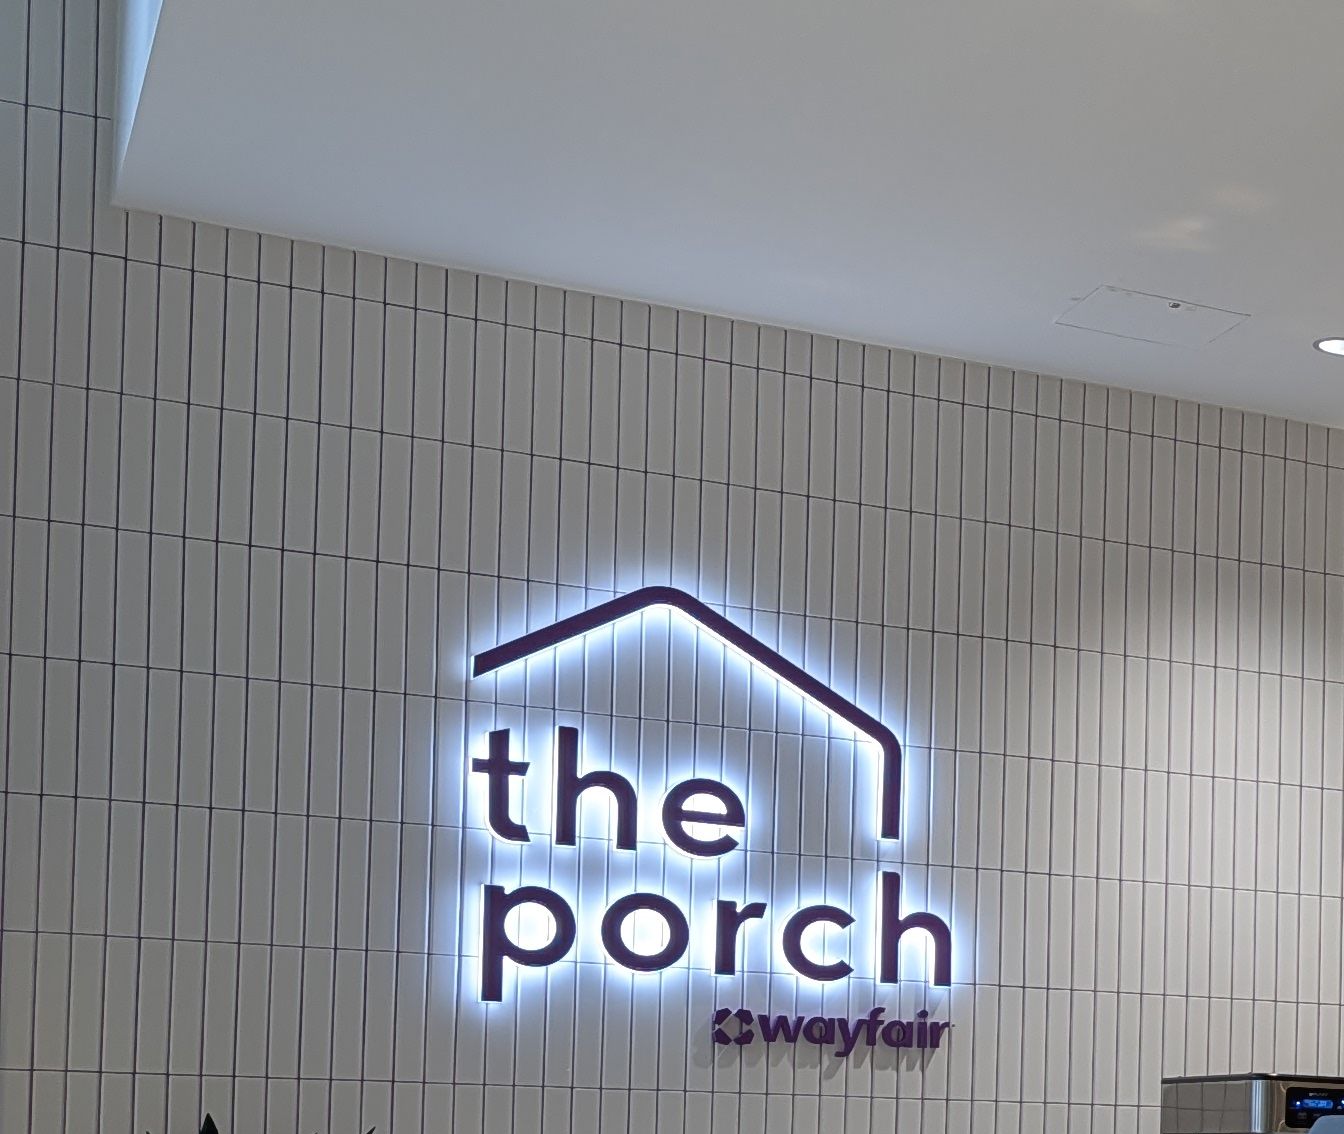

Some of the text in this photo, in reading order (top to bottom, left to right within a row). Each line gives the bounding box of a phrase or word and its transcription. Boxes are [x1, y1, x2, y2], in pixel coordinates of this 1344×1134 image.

[471, 726, 745, 858] the
[478, 870, 952, 1003] porch
[757, 1007, 951, 1058] wayfair
